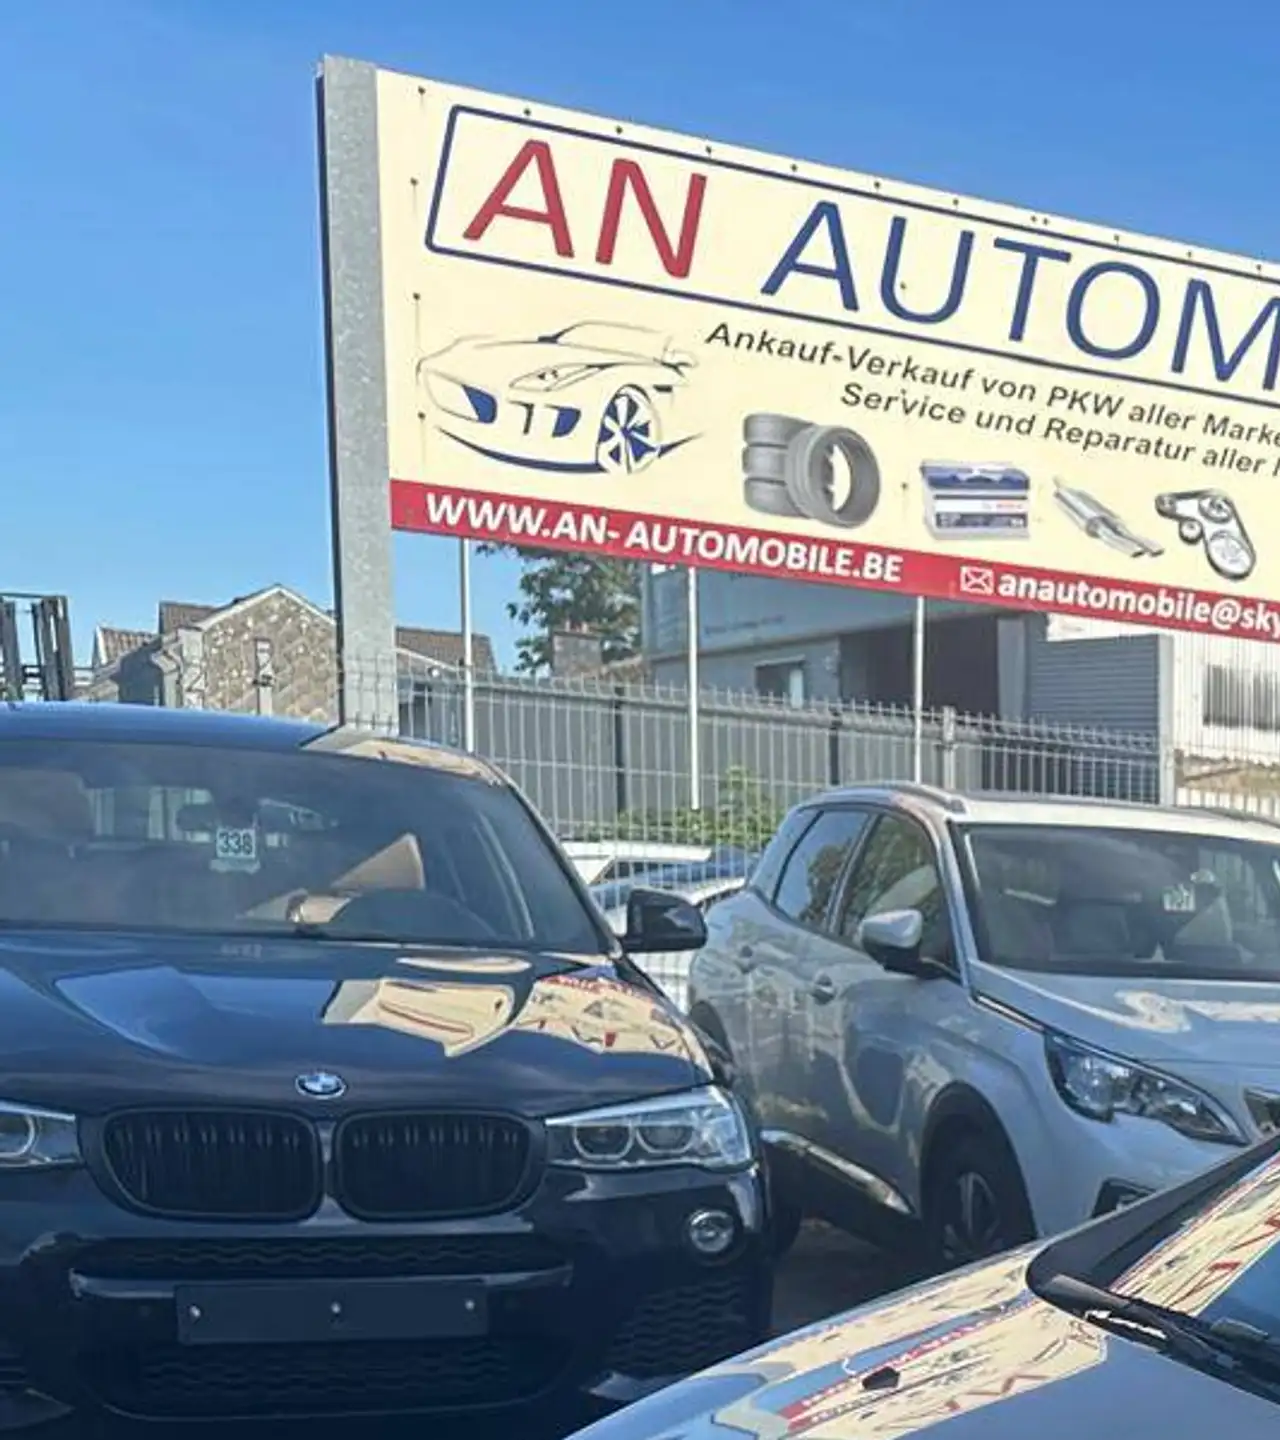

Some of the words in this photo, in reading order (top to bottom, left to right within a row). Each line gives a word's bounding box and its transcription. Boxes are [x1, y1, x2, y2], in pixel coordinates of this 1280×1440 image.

[463, 140, 707, 279] AN
[704, 322, 974, 391] Ankauf-Verkauf
[981, 375, 1037, 403] von
[1046, 384, 1124, 419] PKW
[1127, 402, 1197, 432] aller
[840, 381, 967, 425] Service
[974, 411, 1037, 437] und
[1043, 416, 1197, 462] Reparatur
[1201, 446, 1267, 475] aller
[426, 492, 619, 545] WWW.AN-
[625, 519, 904, 583] AUTOMOBILE.BE
